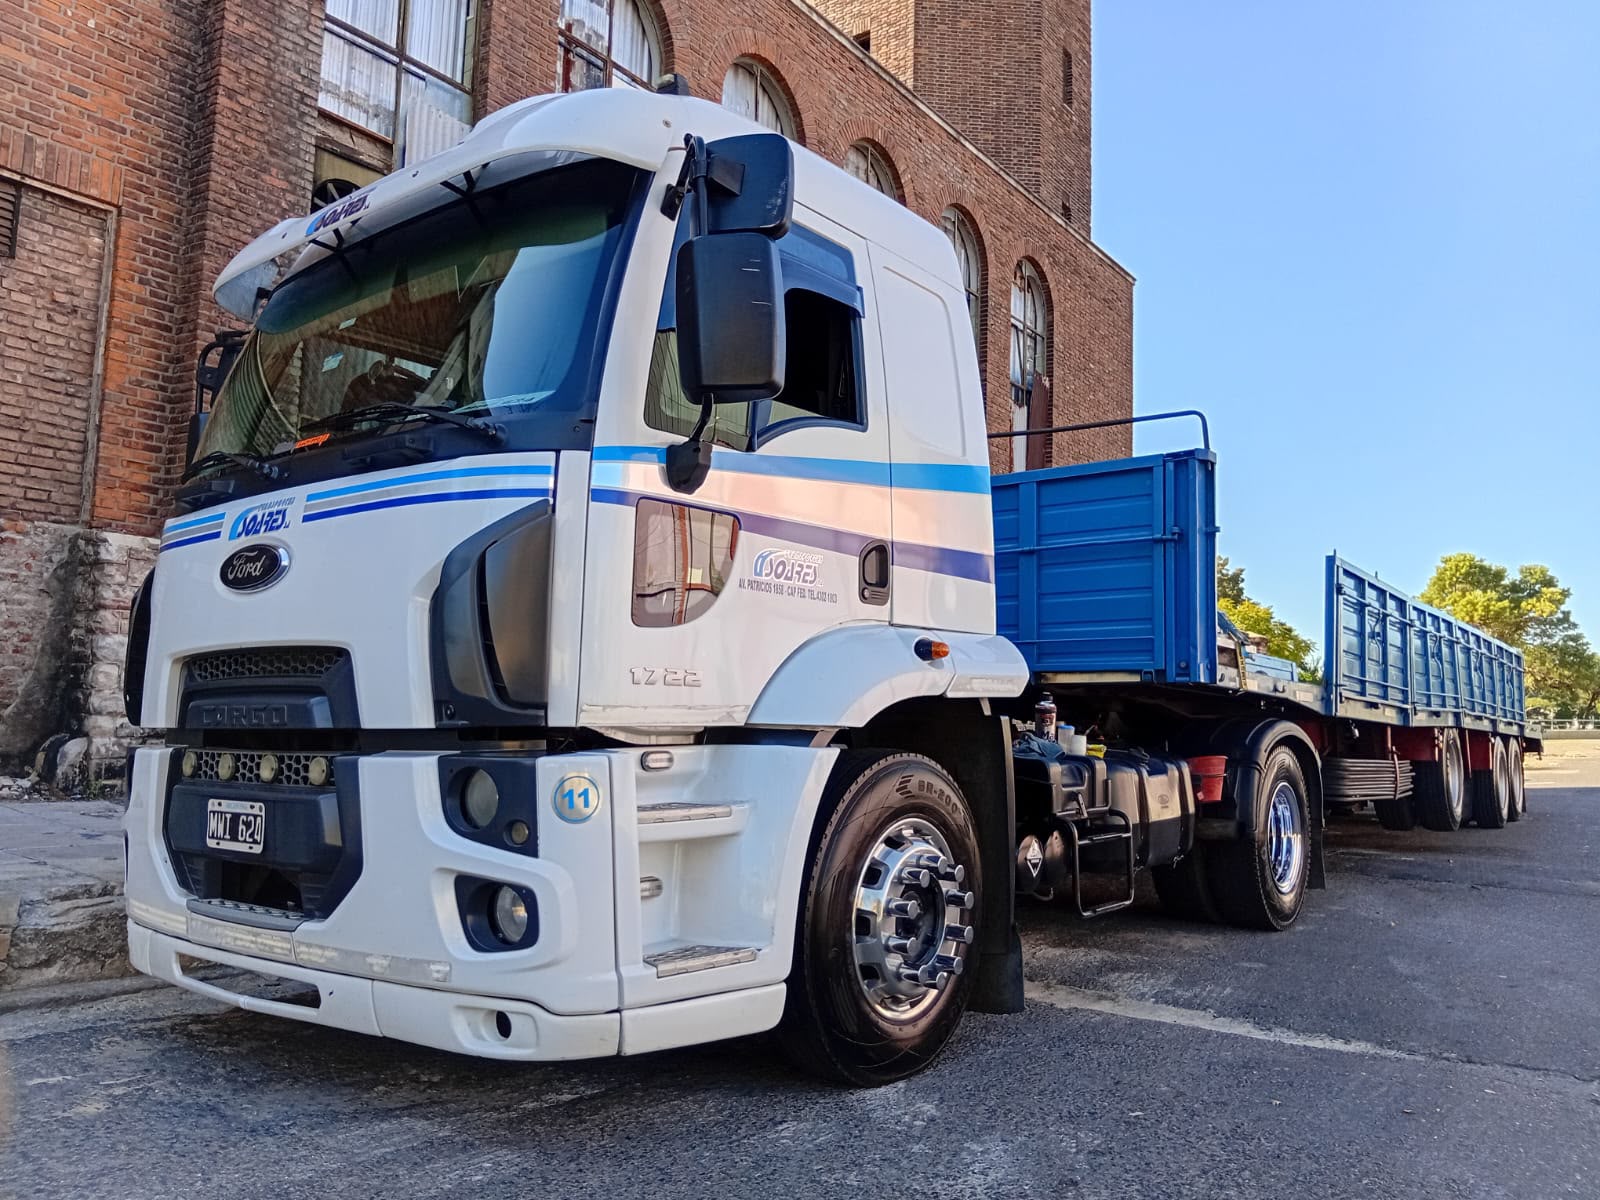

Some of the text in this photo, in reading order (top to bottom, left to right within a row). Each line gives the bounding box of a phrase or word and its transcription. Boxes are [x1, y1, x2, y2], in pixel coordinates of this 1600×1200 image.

[236, 508, 288, 538] SOARES
[227, 550, 266, 580] Ford
[764, 557, 818, 585] SOARES
[629, 666, 702, 687] 1722
[201, 705, 288, 726] CARGO
[562, 788, 589, 809] 11
[208, 812, 262, 842] MWI 624
